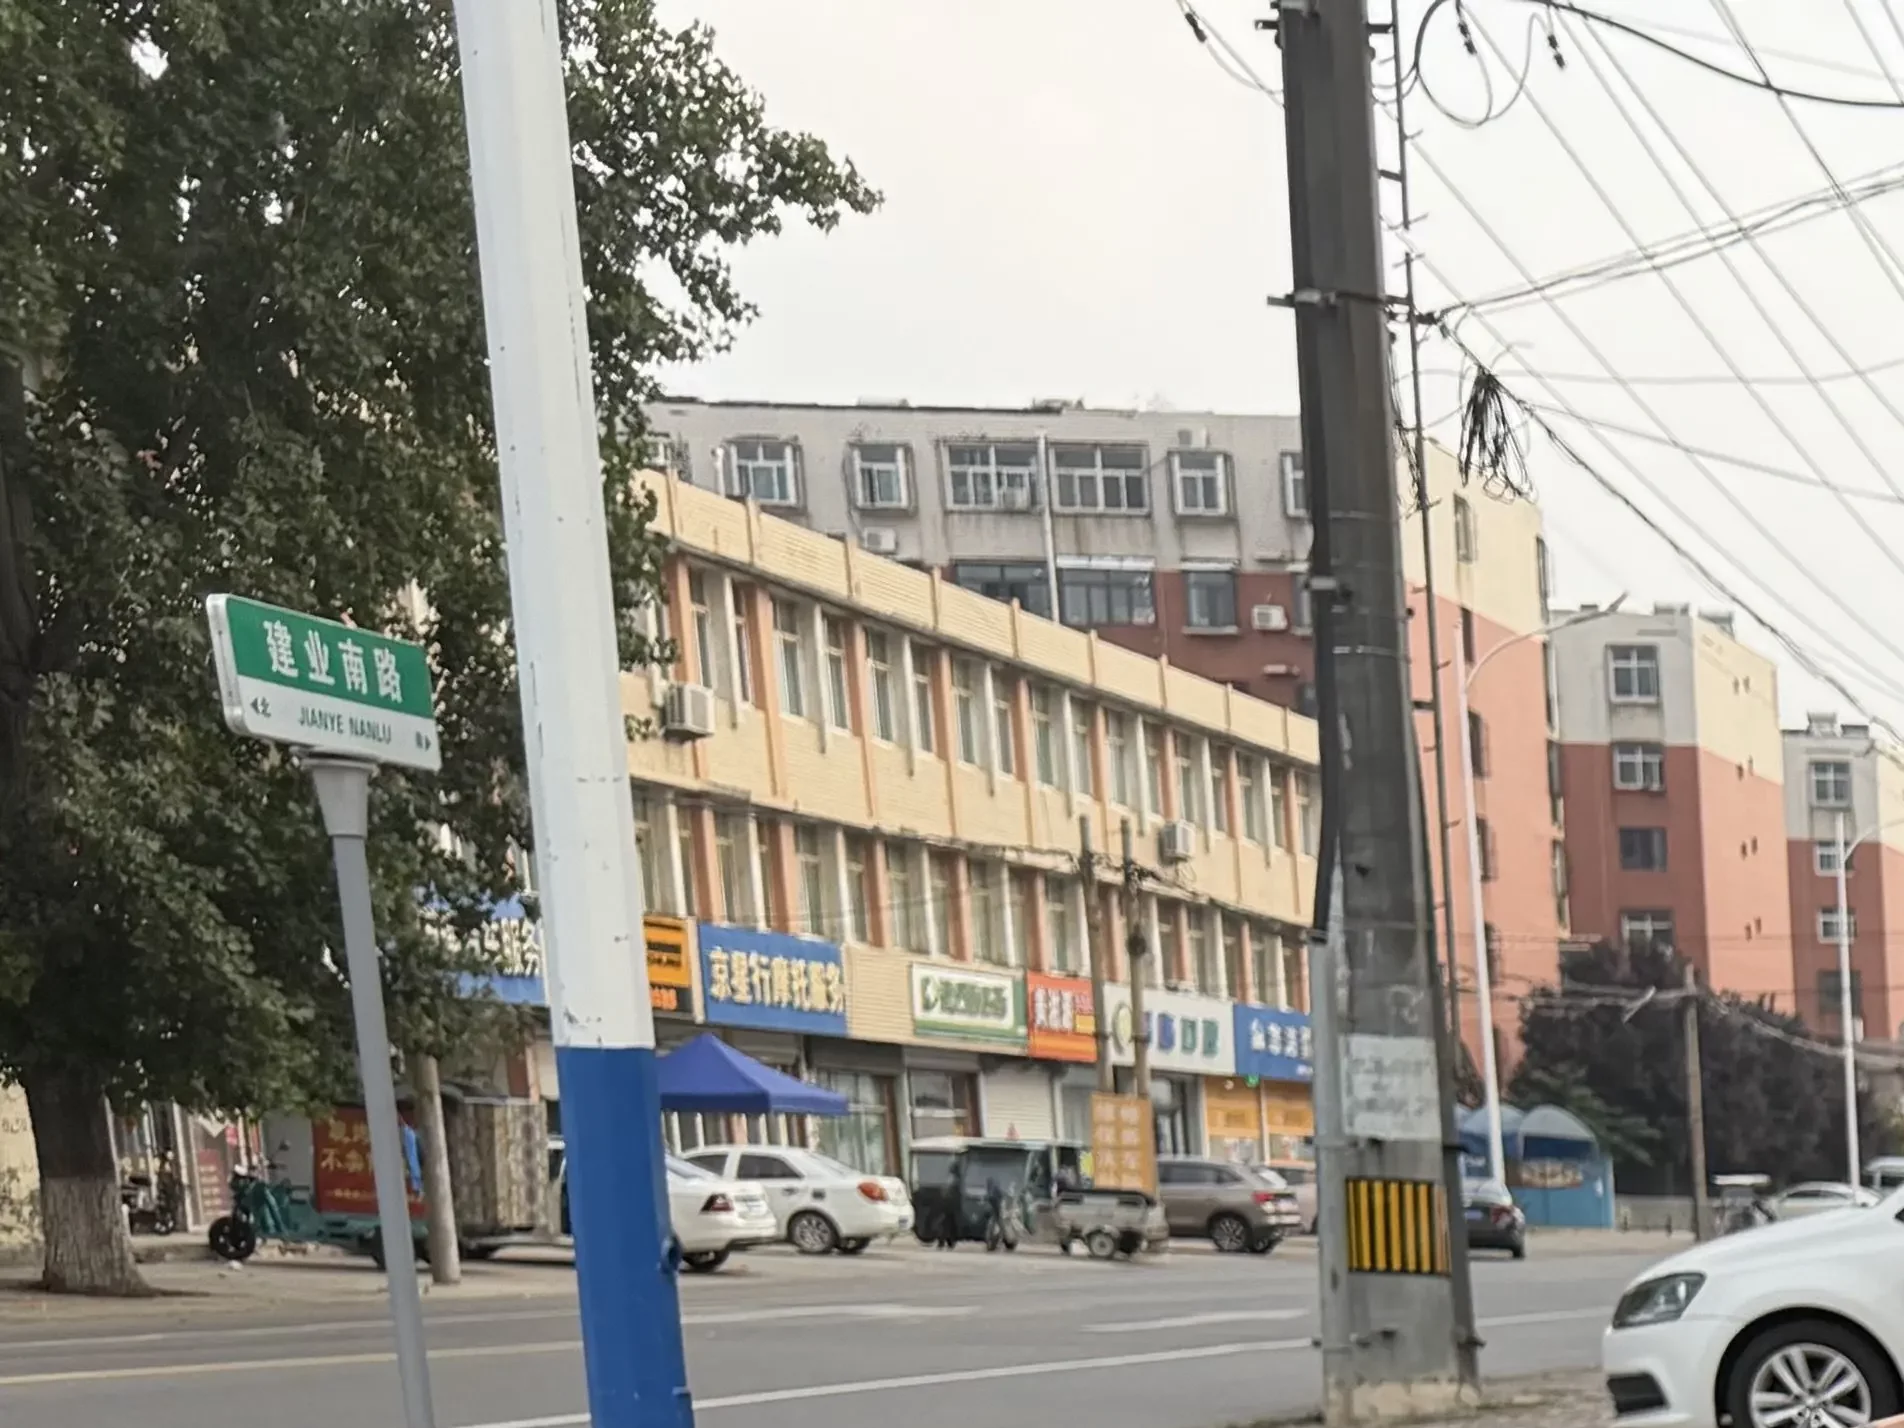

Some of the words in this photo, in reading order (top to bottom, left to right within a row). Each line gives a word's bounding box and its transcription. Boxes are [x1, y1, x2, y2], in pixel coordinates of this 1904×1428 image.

[263, 619, 403, 704] 建业南路
[298, 706, 344, 735] JIANYE
[349, 716, 391, 745] NANLU
